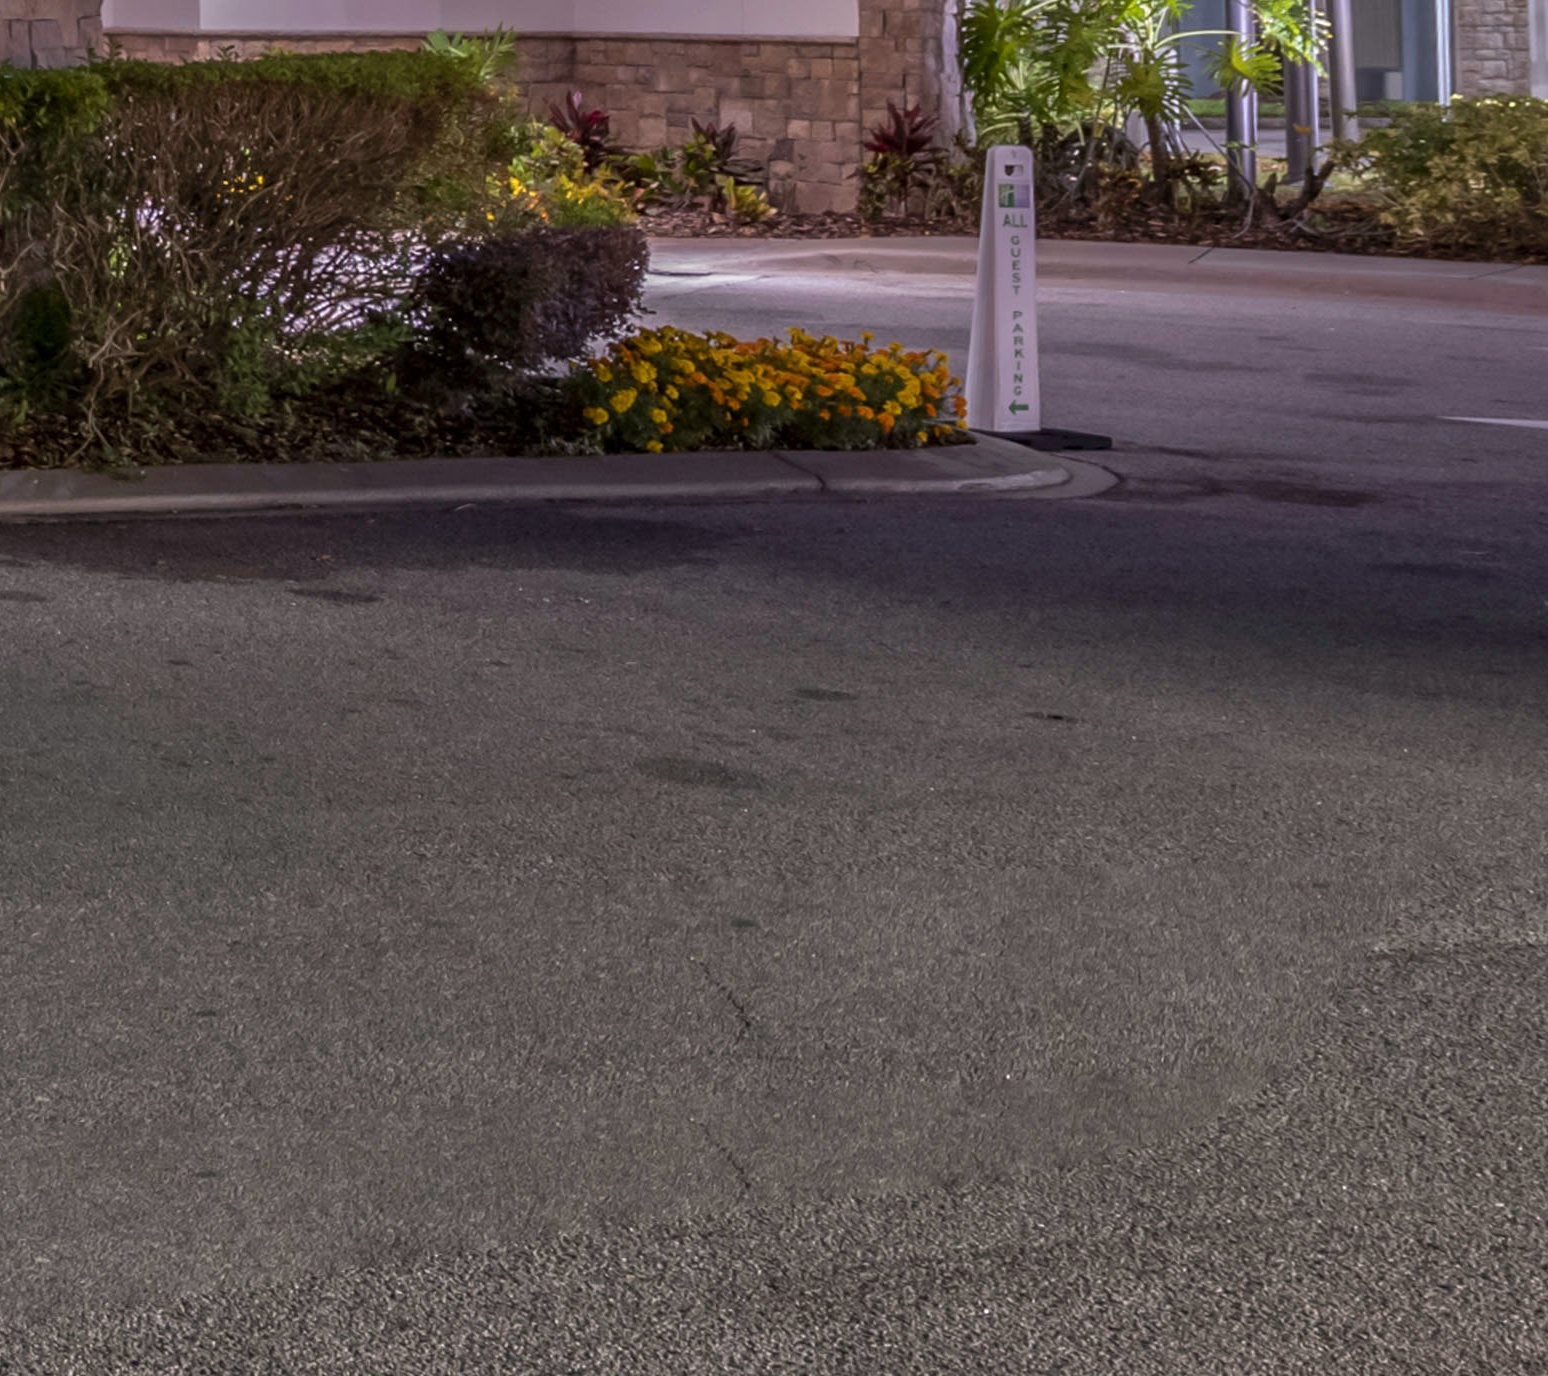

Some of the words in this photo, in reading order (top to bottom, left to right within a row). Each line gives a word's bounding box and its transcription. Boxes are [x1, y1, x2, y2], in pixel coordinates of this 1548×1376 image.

[1002, 213, 1028, 228] ALL
[1010, 235, 1021, 296] GUEST
[1012, 310, 1024, 396] PARKING
